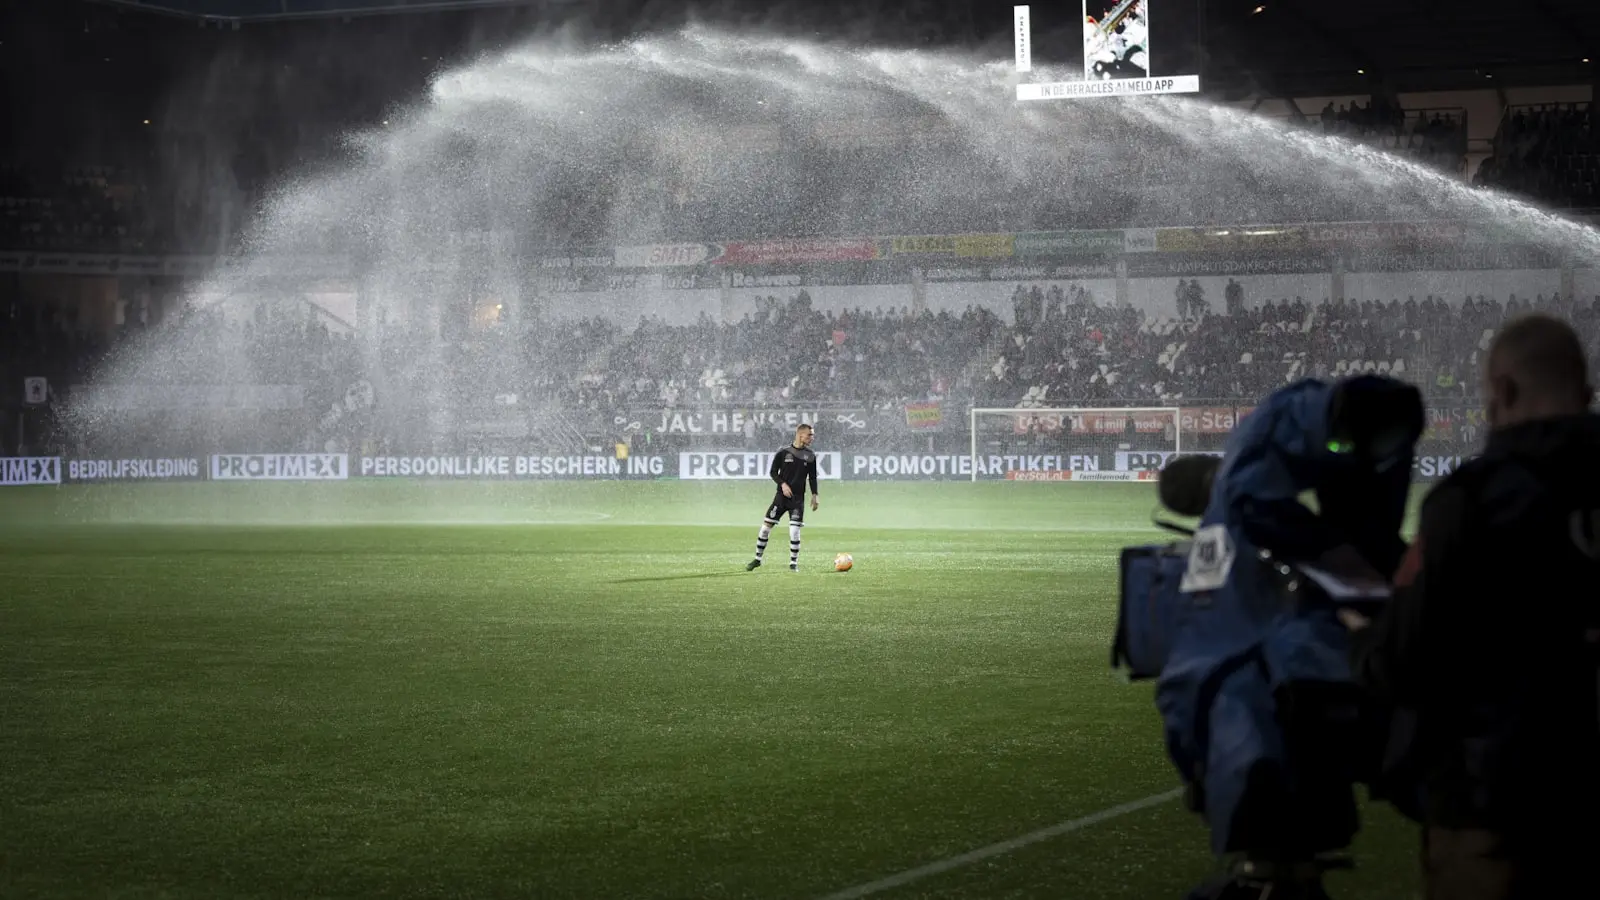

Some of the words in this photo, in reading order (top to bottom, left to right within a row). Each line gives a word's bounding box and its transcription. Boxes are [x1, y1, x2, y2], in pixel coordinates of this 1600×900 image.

[1040, 86, 1050, 97] IN
[1053, 86, 1063, 96] DE
[1066, 82, 1112, 94] HERACLES
[1115, 80, 1151, 93] ALMELO
[1154, 79, 1173, 90] APP
[657, 413, 703, 432] JAC
[1095, 417, 1162, 430] familimode
[69, 459, 198, 478] BEDRIJFSKLEDING
[217, 455, 341, 477] PROFIMEX
[361, 456, 510, 475] PERSOONLIJKE
[515, 456, 663, 475] BESCHERMING
[688, 453, 833, 476] PROFIX
